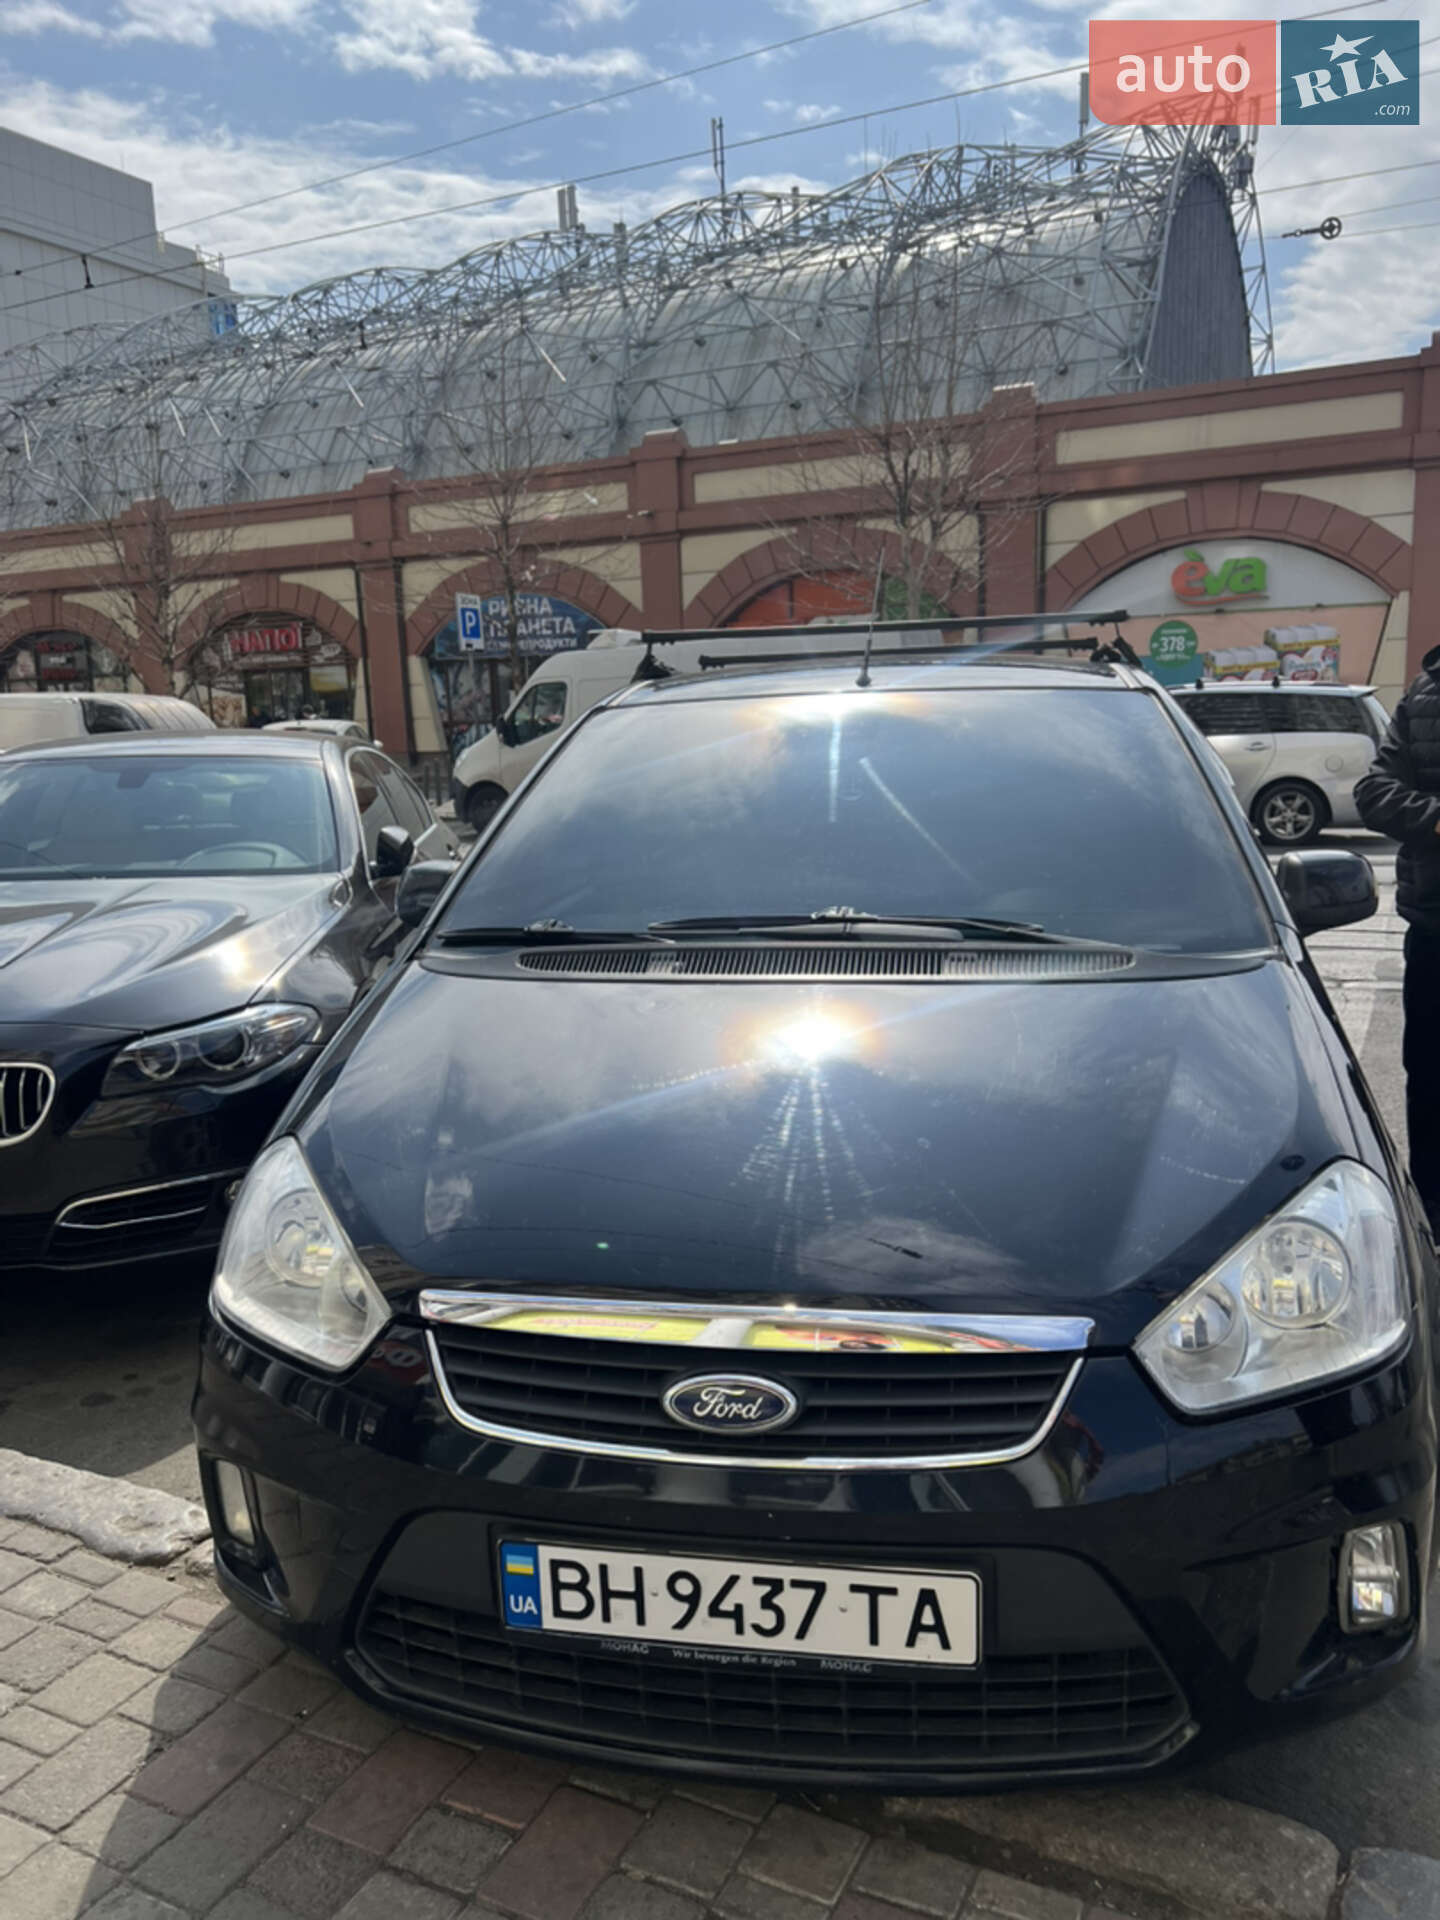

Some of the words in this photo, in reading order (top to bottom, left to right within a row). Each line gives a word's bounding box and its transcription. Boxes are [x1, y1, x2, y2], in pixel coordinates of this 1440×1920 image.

[1159, 636, 1185, 652] 378
[693, 1386, 764, 1419] Ford
[509, 1594, 538, 1615] UA
[548, 1558, 647, 1627] BH
[665, 1570, 827, 1641] 9437
[849, 1583, 952, 1651] TA
[672, 1648, 692, 1659] Wir
[694, 1650, 740, 1664] bewegen
[742, 1654, 758, 1664] die
[760, 1656, 797, 1668] Region
